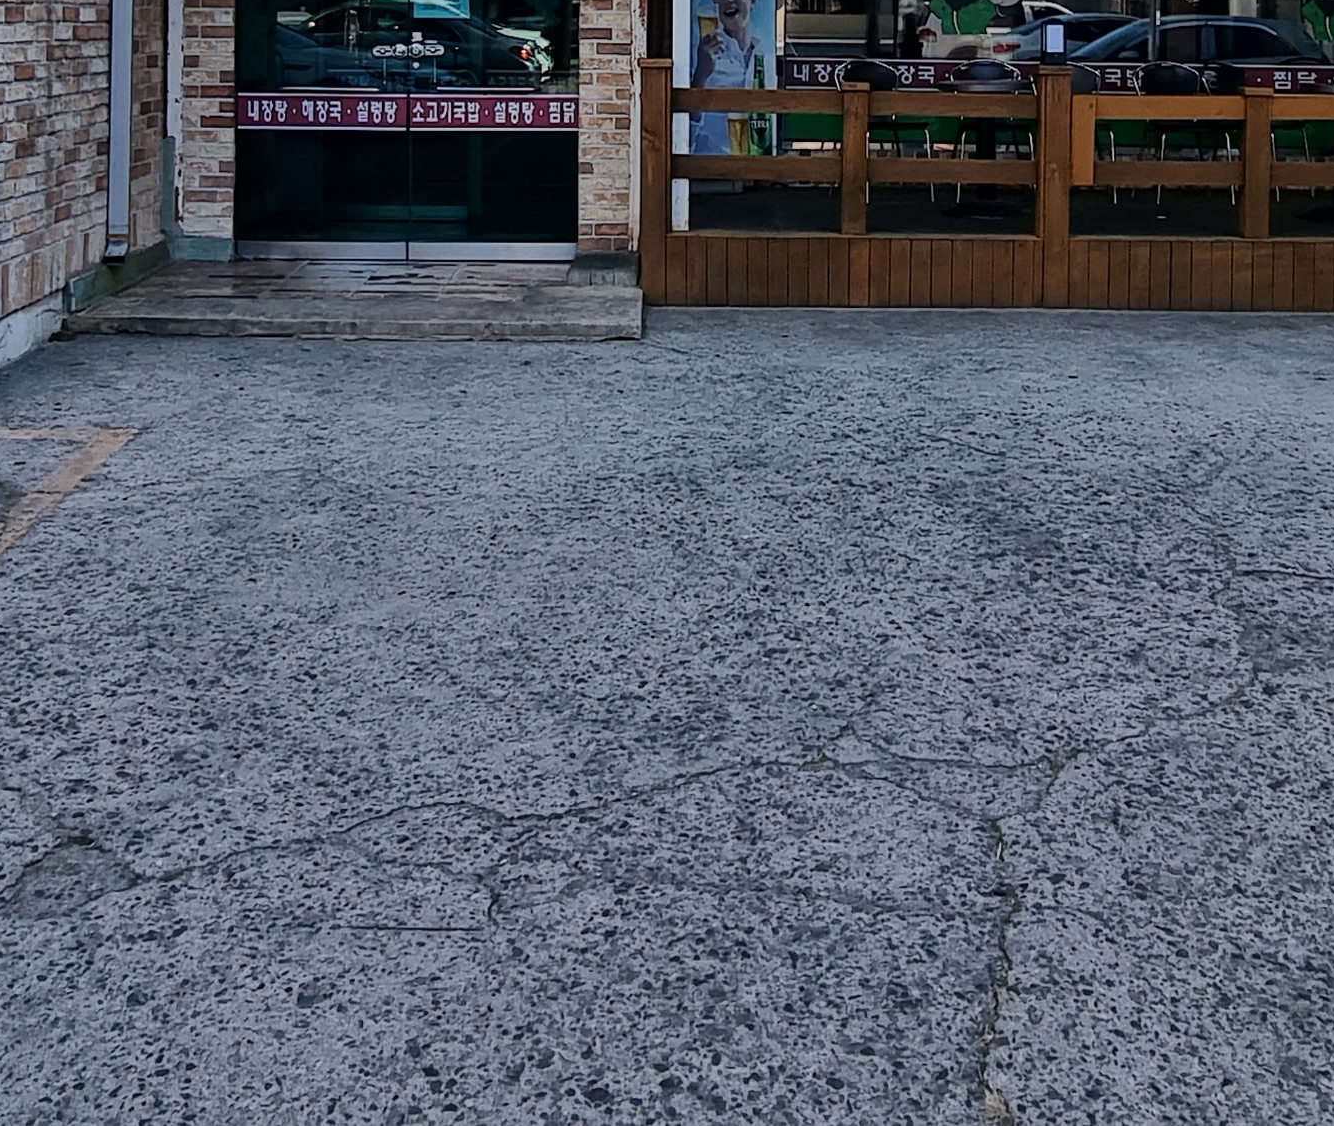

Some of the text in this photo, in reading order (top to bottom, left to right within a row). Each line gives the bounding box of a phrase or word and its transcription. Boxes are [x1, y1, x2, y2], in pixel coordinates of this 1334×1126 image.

[896, 64, 935, 85] 장국
[247, 99, 397, 123] 내장탕 해장국 설렁탕
[412, 101, 576, 123] 소고기국밥 설렁탕 찜닭
